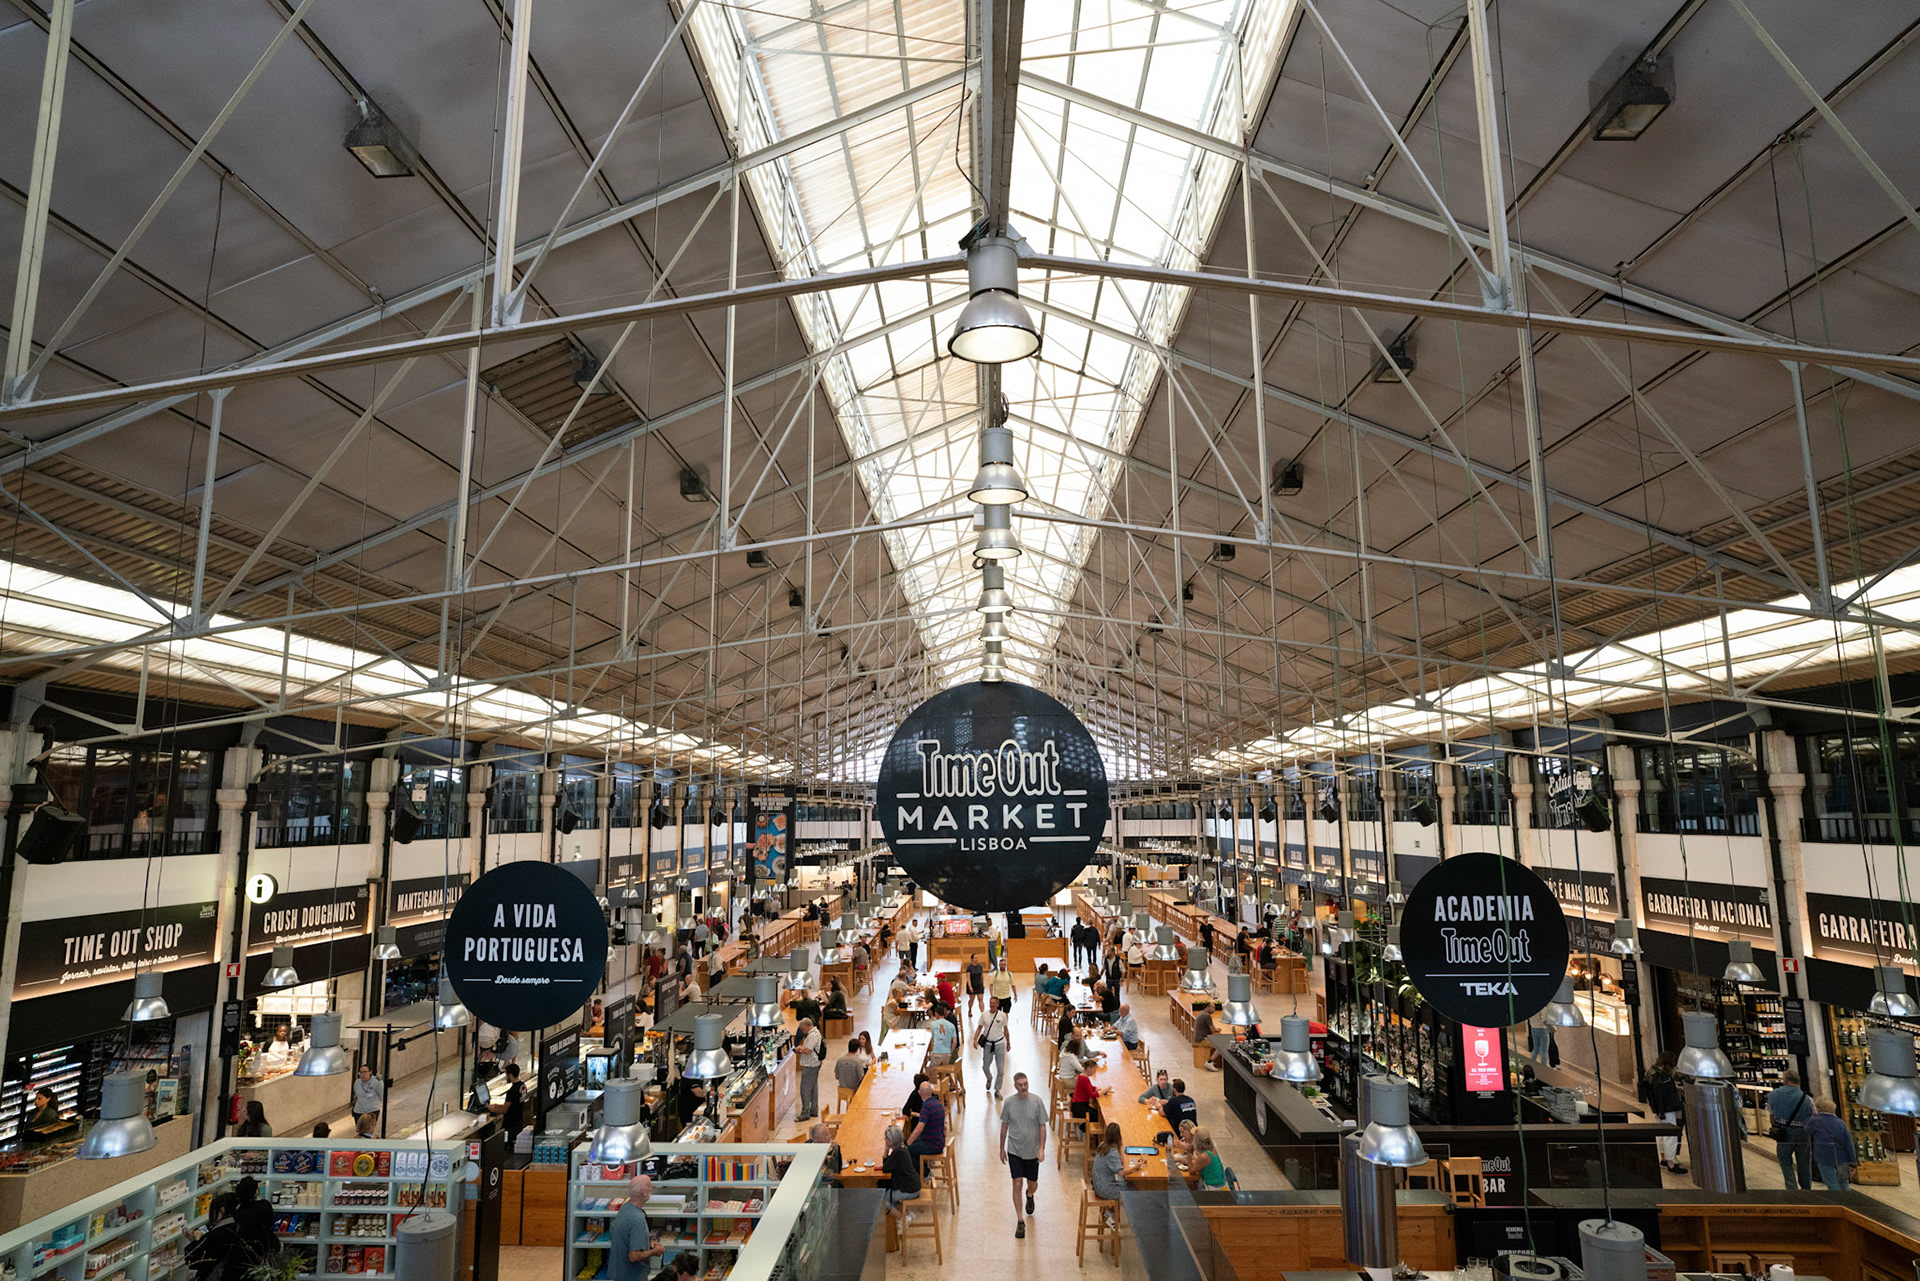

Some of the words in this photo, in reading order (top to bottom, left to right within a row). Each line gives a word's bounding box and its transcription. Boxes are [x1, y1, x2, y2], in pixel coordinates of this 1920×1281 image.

[897, 803, 1088, 831] MARKET
[960, 837, 1028, 851] LISBOA
[397, 888, 444, 912] MANTEIGARIA
[1558, 879, 1564, 899] É
[1564, 883, 1583, 902] MAIS
[1584, 885, 1610, 906] BOLOS
[263, 908, 299, 934] CRUSH
[302, 901, 356, 927] DOUGHNUTS
[493, 904, 505, 928] A
[513, 904, 557, 928] VIDA
[1434, 895, 1535, 922] ACADEMIA
[1647, 892, 1709, 920] GARRAFEIRA
[1711, 900, 1772, 928] NACIONAL
[64, 933, 106, 965] TIME
[110, 928, 142, 958] OUT
[144, 922, 183, 952] SHOP
[1819, 912, 1918, 951] GARRAFEIRA
[463, 937, 584, 962] PORTUGUESA
[60, 969, 91, 985] Jornais,
[92, 965, 121, 977] revistas,
[158, 954, 179, 964] tabaco
[495, 975, 520, 985] Desde
[520, 976, 551, 985] sempre
[1460, 982, 1519, 996] TEKA
[1482, 1178, 1506, 1193] BAR
